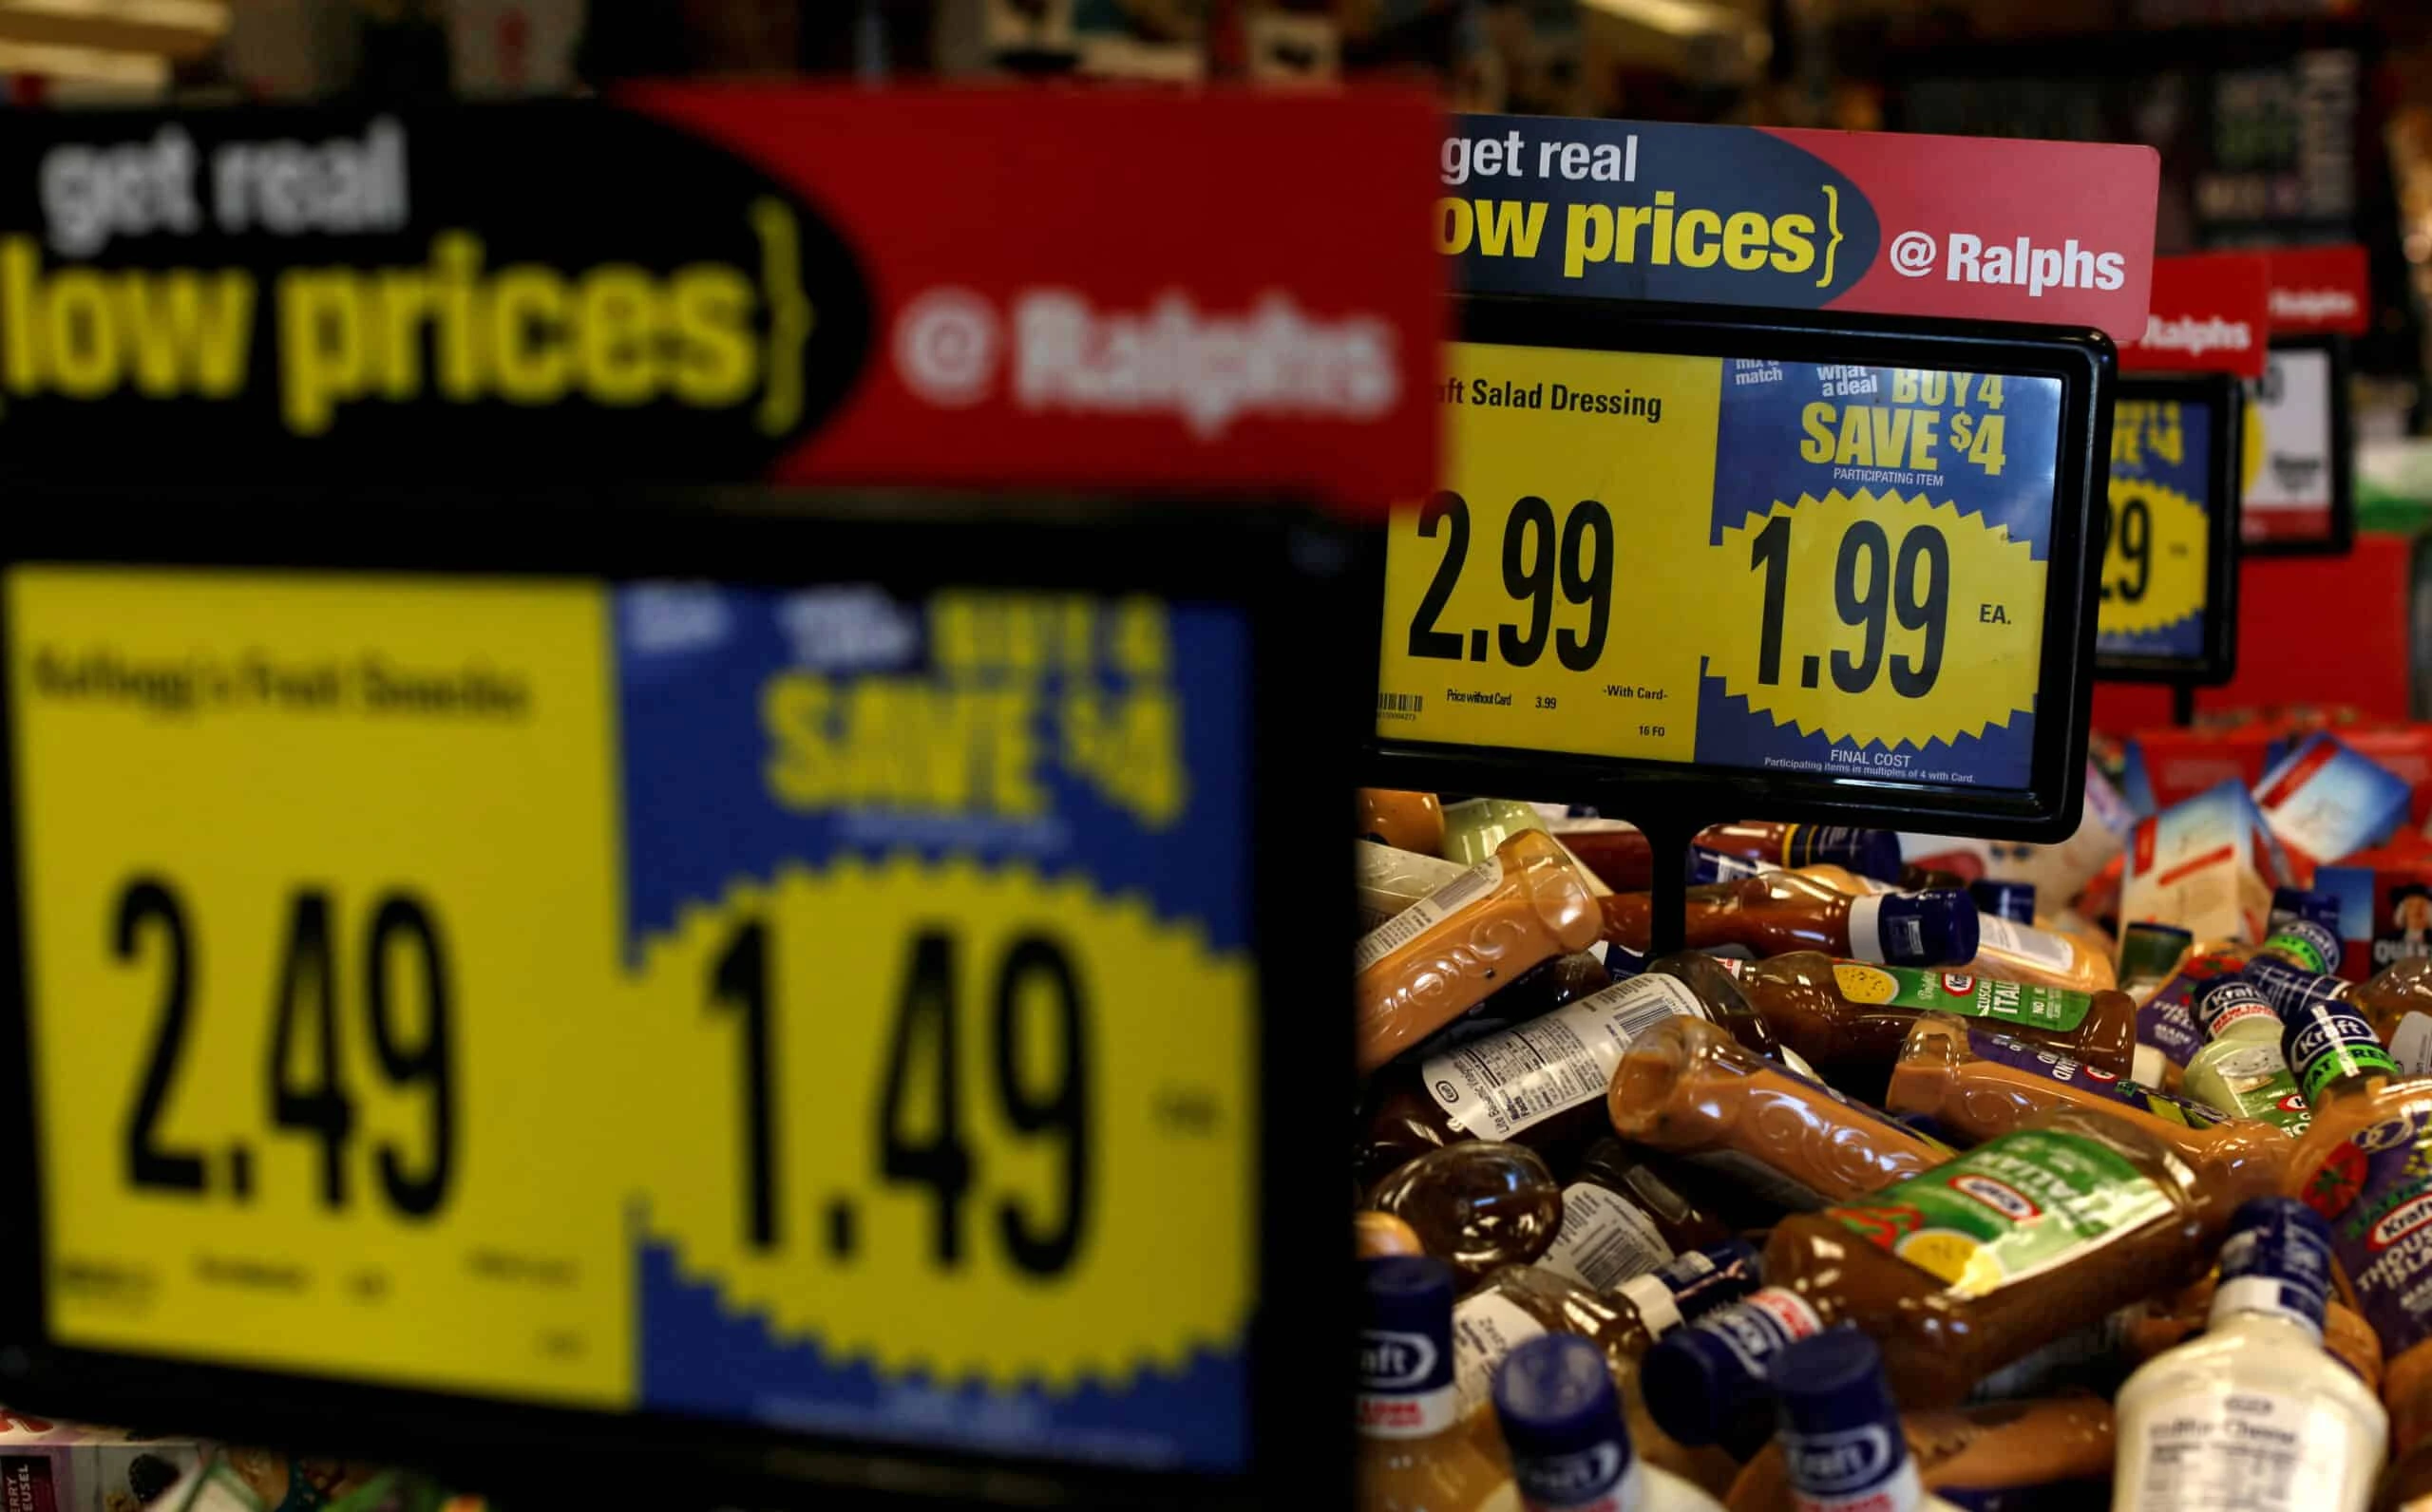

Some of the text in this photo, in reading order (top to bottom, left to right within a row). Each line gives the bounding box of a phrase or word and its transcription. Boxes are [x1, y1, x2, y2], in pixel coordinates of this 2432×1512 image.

[1441, 130, 1638, 185] get real
[40, 113, 409, 255] get real
[1434, 197, 1548, 258] ow
[1947, 233, 2125, 297] Ralphs
[0, 234, 253, 399] low
[1013, 288, 1404, 437] Ralphs
[1736, 367, 1783, 386] match
[1816, 364, 1868, 382] what
[1435, 377, 1662, 424] aft Salad Dressing
[1822, 375, 1878, 397] a deal
[1891, 368, 2004, 409] BUY 4
[1800, 402, 2005, 476] SAVE $4
[1834, 467, 1945, 486] PARTICIPATING ITEM
[1408, 490, 1615, 672] 2.99
[1750, 516, 1950, 698] 1.99
[1979, 603, 2013, 625] EA.
[1446, 688, 1512, 706] Price without Card
[1535, 696, 1557, 710] 3.99
[1639, 725, 1650, 736] 16
[1763, 757, 1823, 772] Participating
[1824, 762, 1851, 773] items
[1852, 765, 1862, 774] in
[1863, 766, 1906, 778] multiples
[1908, 767, 1918, 778] of
[1919, 770, 1927, 779] 4
[1928, 771, 1948, 781] with
[1830, 748, 1912, 768] FINAL COST
[1977, 979, 1993, 1013] TUSCA
[109, 872, 466, 1223] 2.49
[701, 912, 1100, 1291] 1.49
[1360, 1344, 1407, 1375] aft
[17, 1463, 35, 1512] EUSEL
